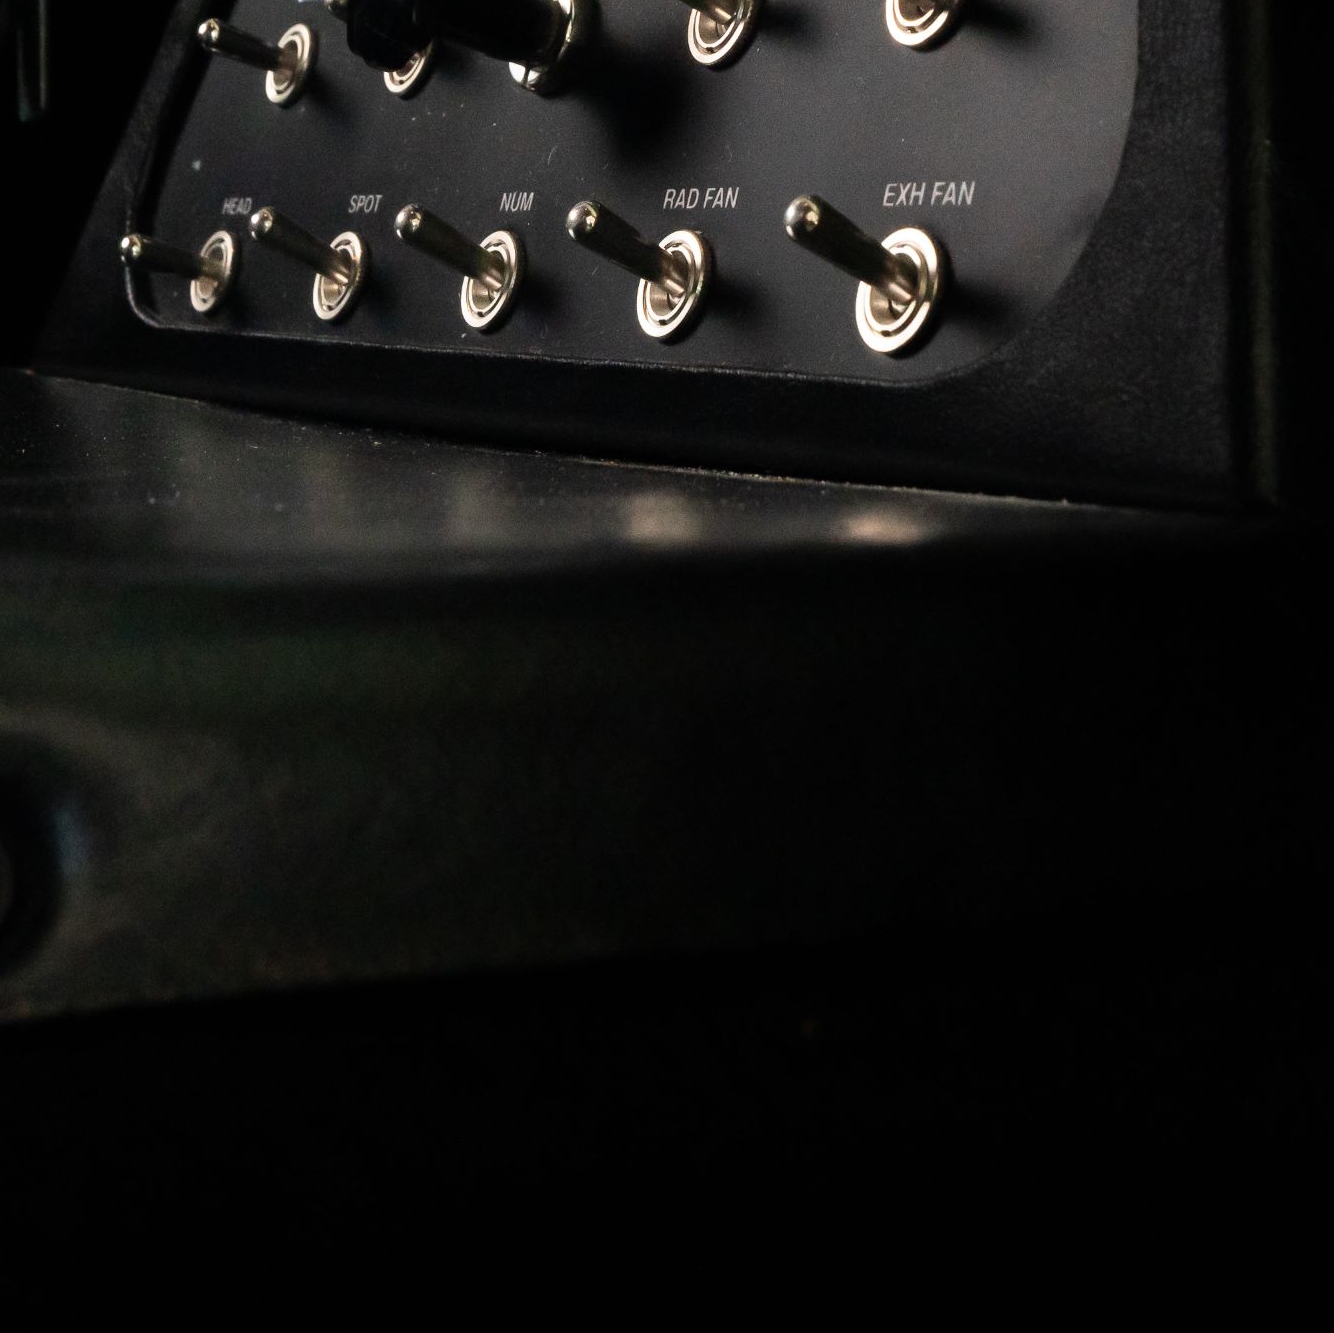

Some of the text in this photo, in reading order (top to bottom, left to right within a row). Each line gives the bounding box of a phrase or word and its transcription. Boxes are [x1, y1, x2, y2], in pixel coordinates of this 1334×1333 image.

[347, 194, 383, 213] SPOT
[499, 192, 535, 212] NUM
[662, 186, 740, 209] RAD FAN
[882, 180, 976, 207] EXH FAN
[221, 197, 253, 215] HEAD
